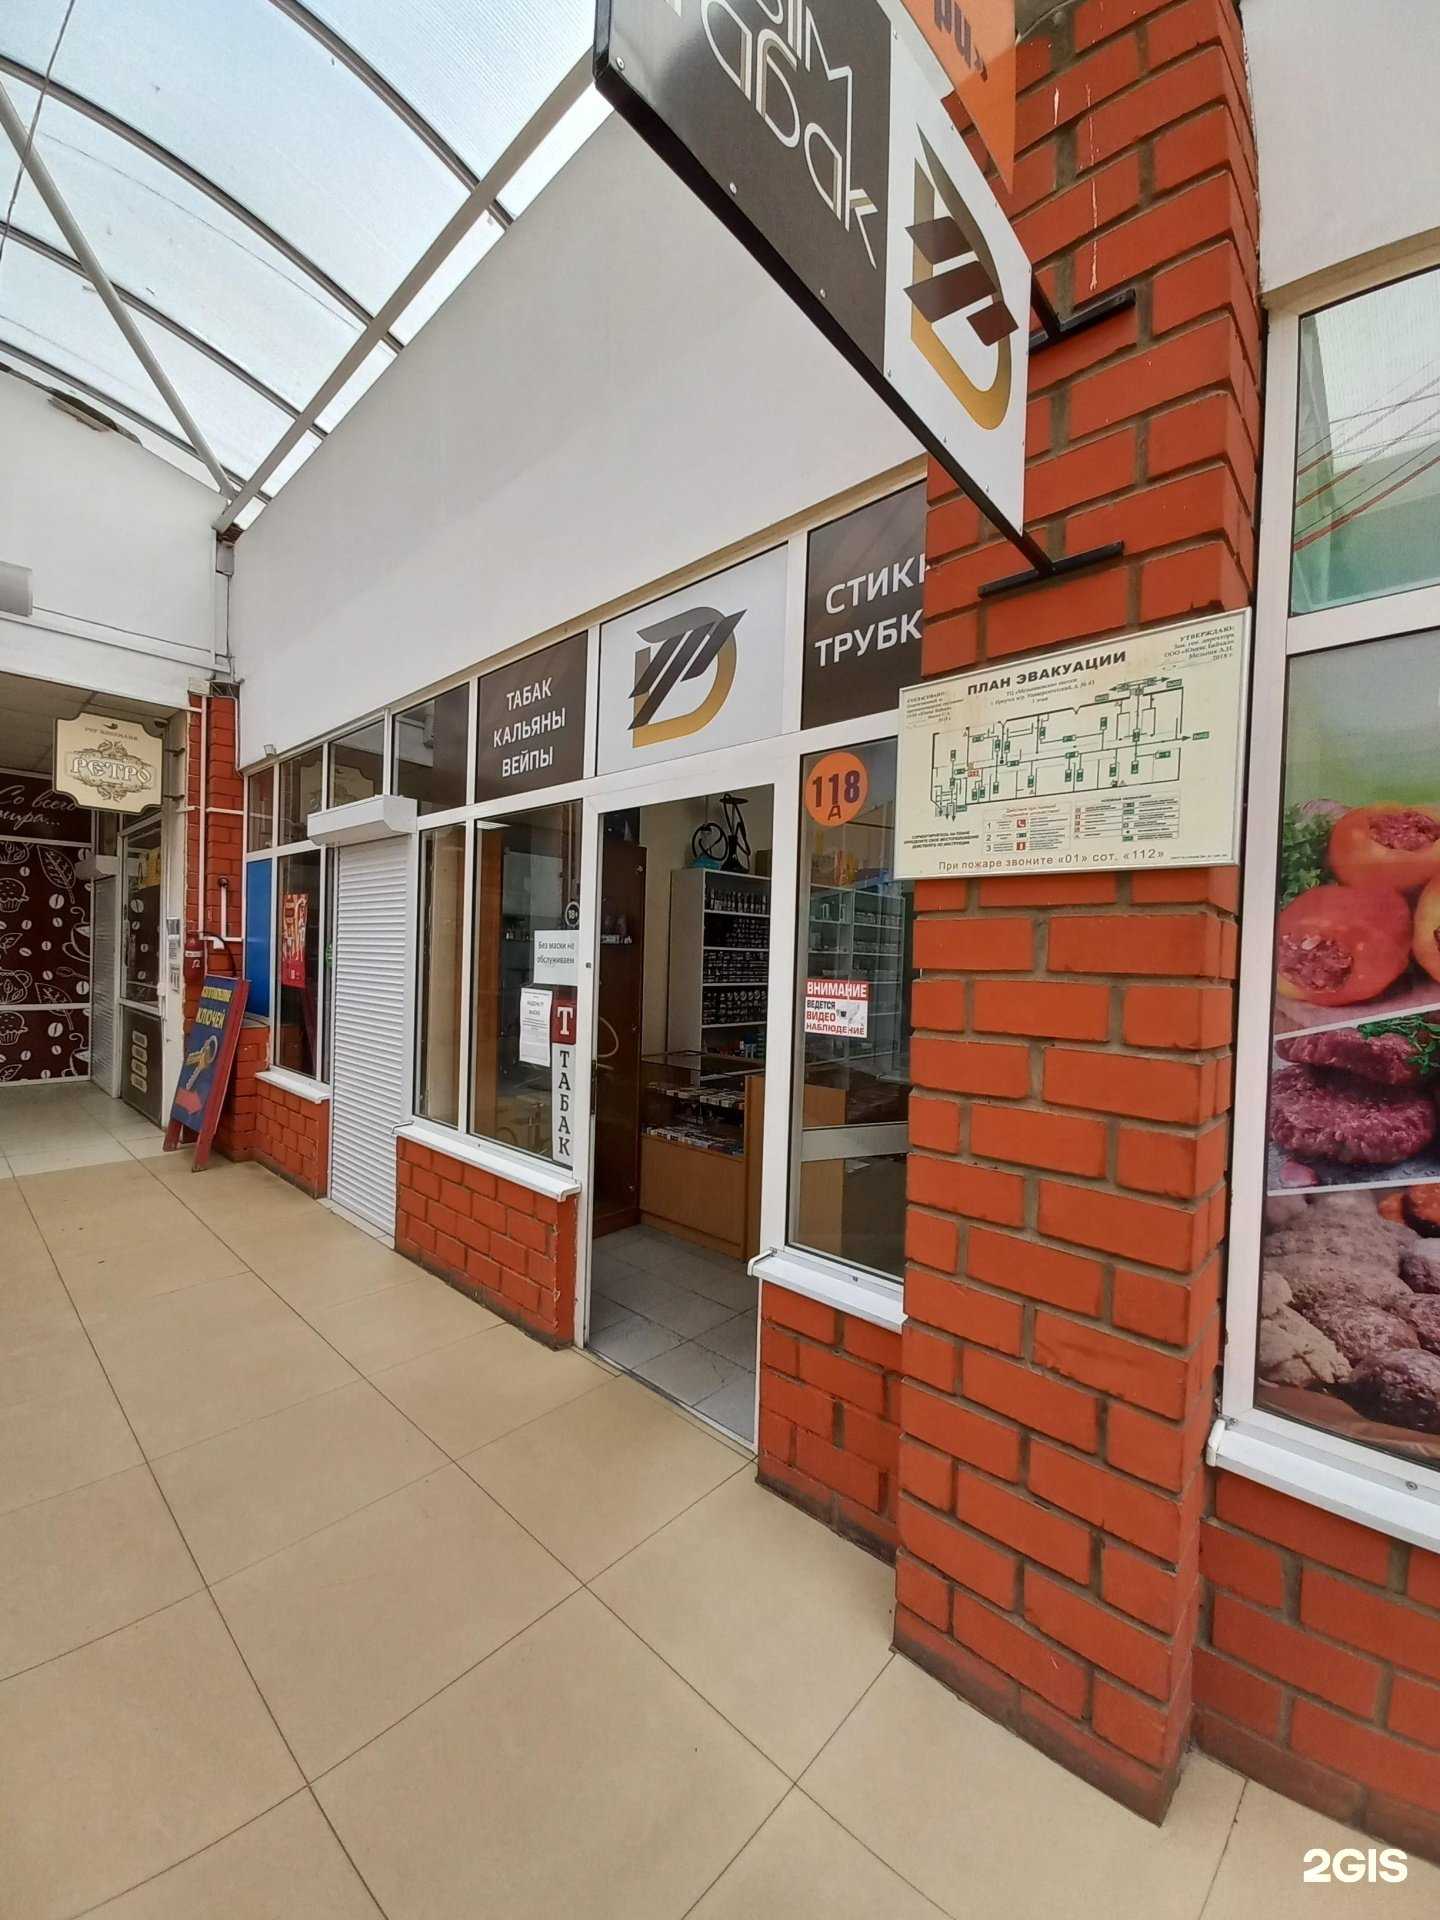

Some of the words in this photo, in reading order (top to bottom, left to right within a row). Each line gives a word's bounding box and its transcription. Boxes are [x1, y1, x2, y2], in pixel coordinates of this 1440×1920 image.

[967, 675, 1012, 696] ПЛАН
[1016, 650, 1127, 685] ЭВАКУАЦИИ
[506, 677, 553, 711] ТАБАК
[493, 707, 566, 748] КАЛЬЯНЫ
[502, 746, 553, 777] ВЕЙПЫ
[812, 770, 860, 808] 118
[938, 860, 958, 872] При
[961, 859, 1003, 871] пожаре
[1006, 856, 1054, 868] звоните
[806, 981, 868, 998] ВНИМАНИЕ
[806, 999, 836, 1010] ВЕДЕТСЯ
[806, 1011, 836, 1023] ВИДЕО
[806, 1022, 865, 1036] НАБЛЮДЕНИЕ
[558, 1049, 572, 1157] ТАБАК
